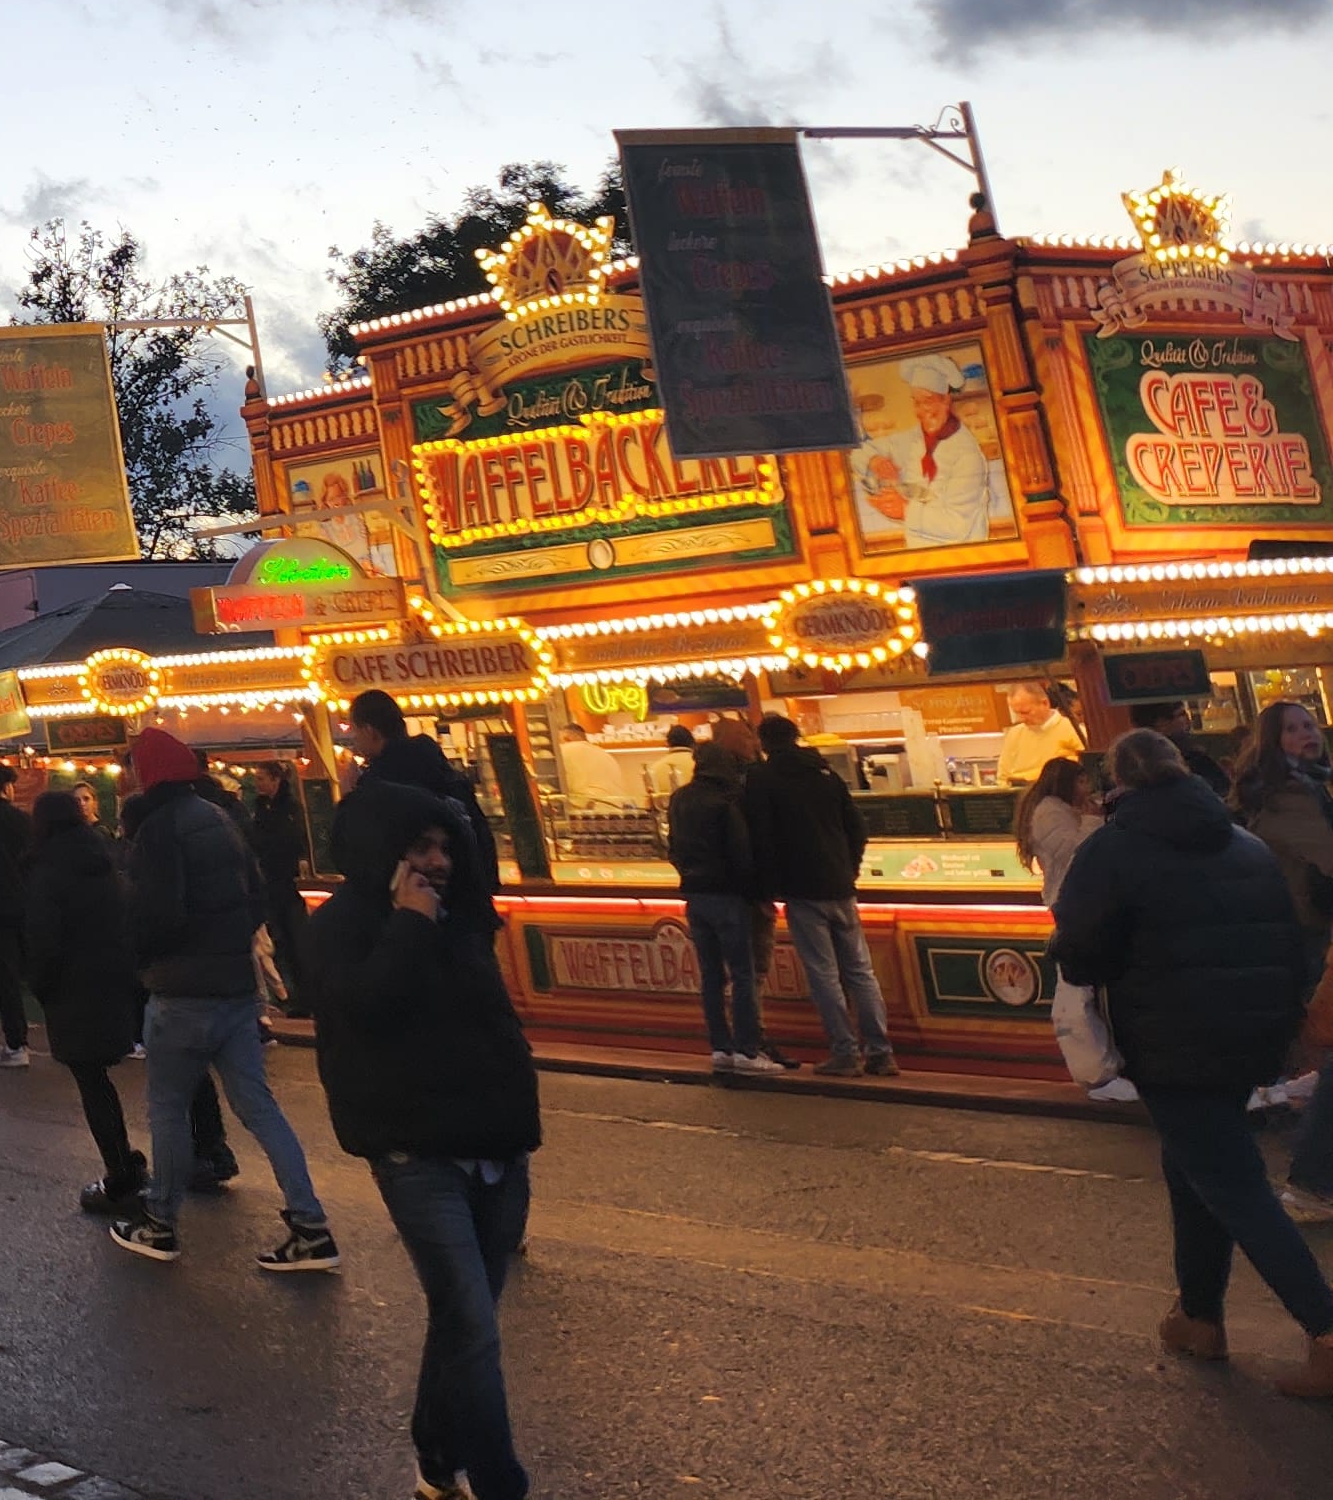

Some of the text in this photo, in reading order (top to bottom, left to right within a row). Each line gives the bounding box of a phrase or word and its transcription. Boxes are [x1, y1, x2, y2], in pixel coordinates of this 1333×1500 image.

[1140, 261, 1233, 286] SCHREIBERS
[500, 308, 630, 356] SCHREIBERS
[0, 363, 73, 392] Waffeln
[1146, 376, 1246, 437] CAFE
[11, 417, 77, 450] Crepes
[1134, 441, 1318, 498] CREPERIE
[17, 478, 83, 506] Kaffee-
[333, 654, 393, 684] CAFE
[394, 641, 532, 680] SCHREIBER
